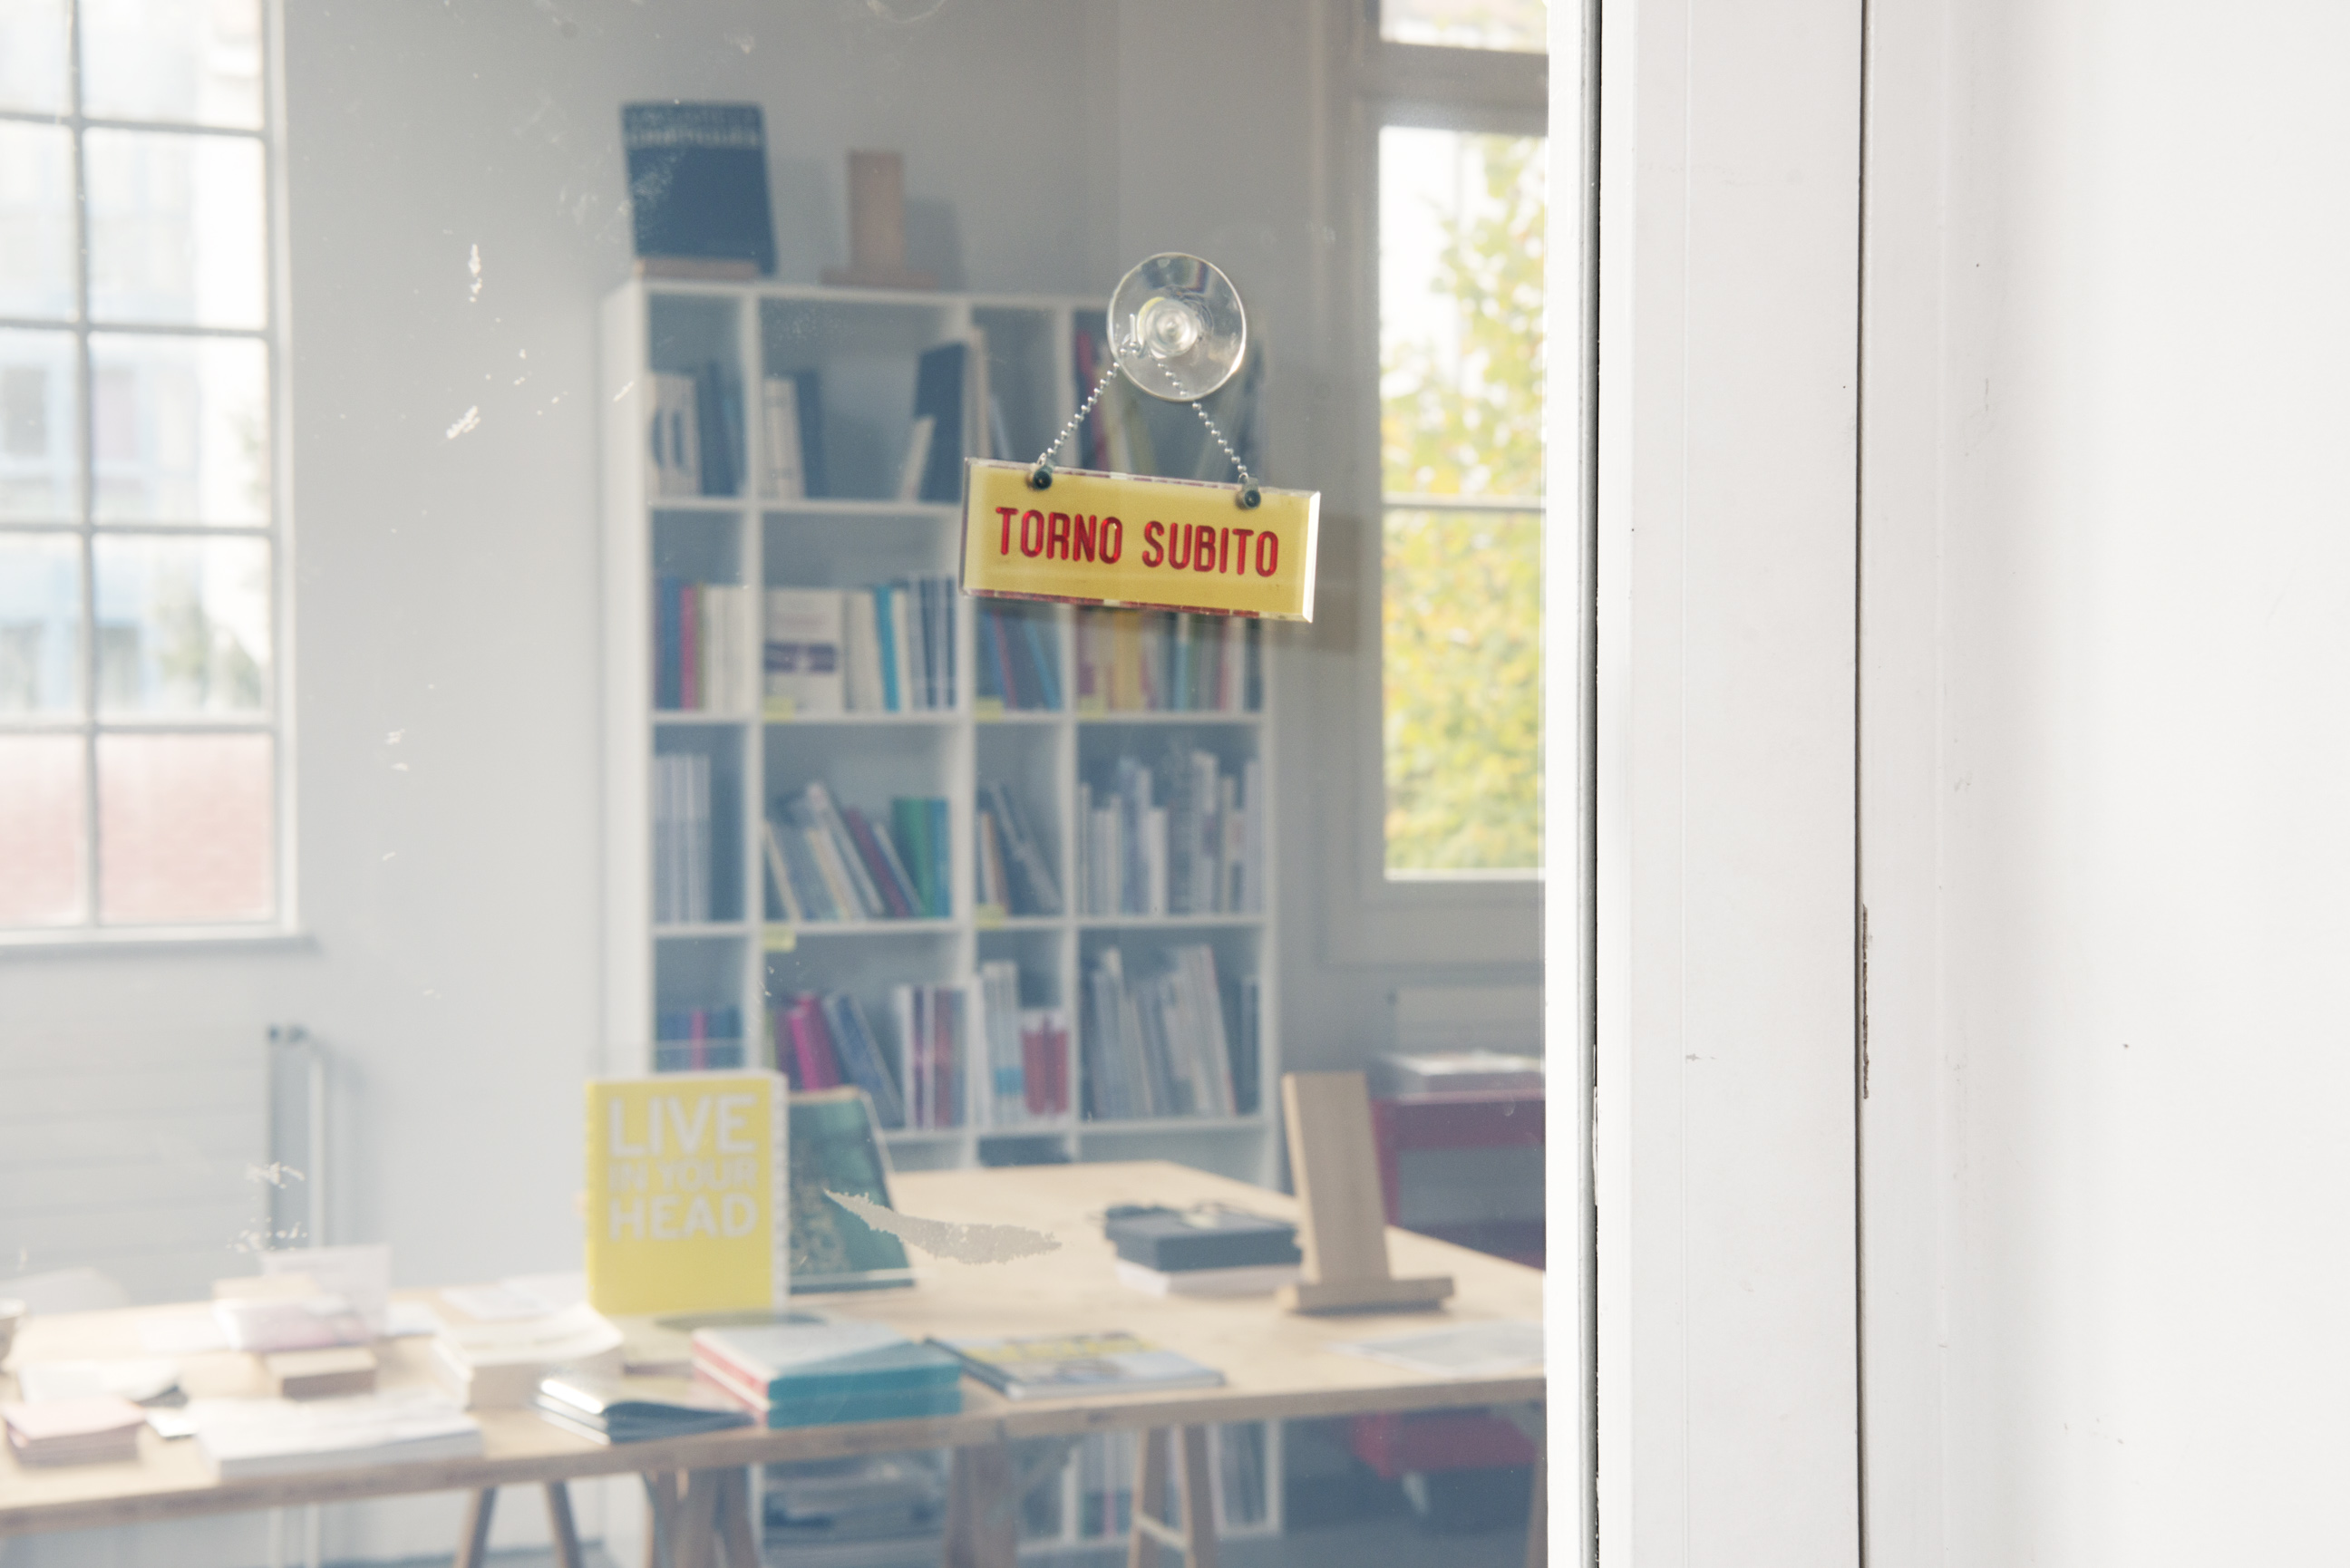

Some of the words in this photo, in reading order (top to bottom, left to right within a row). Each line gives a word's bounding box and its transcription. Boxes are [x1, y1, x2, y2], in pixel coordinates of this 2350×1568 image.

[995, 507, 1123, 565] TORNO
[1141, 520, 1279, 577] SUBITO
[608, 1094, 758, 1157] LIVE
[608, 1162, 647, 1193] IN
[657, 1157, 758, 1191] YOUR
[608, 1193, 759, 1241] HEAD
